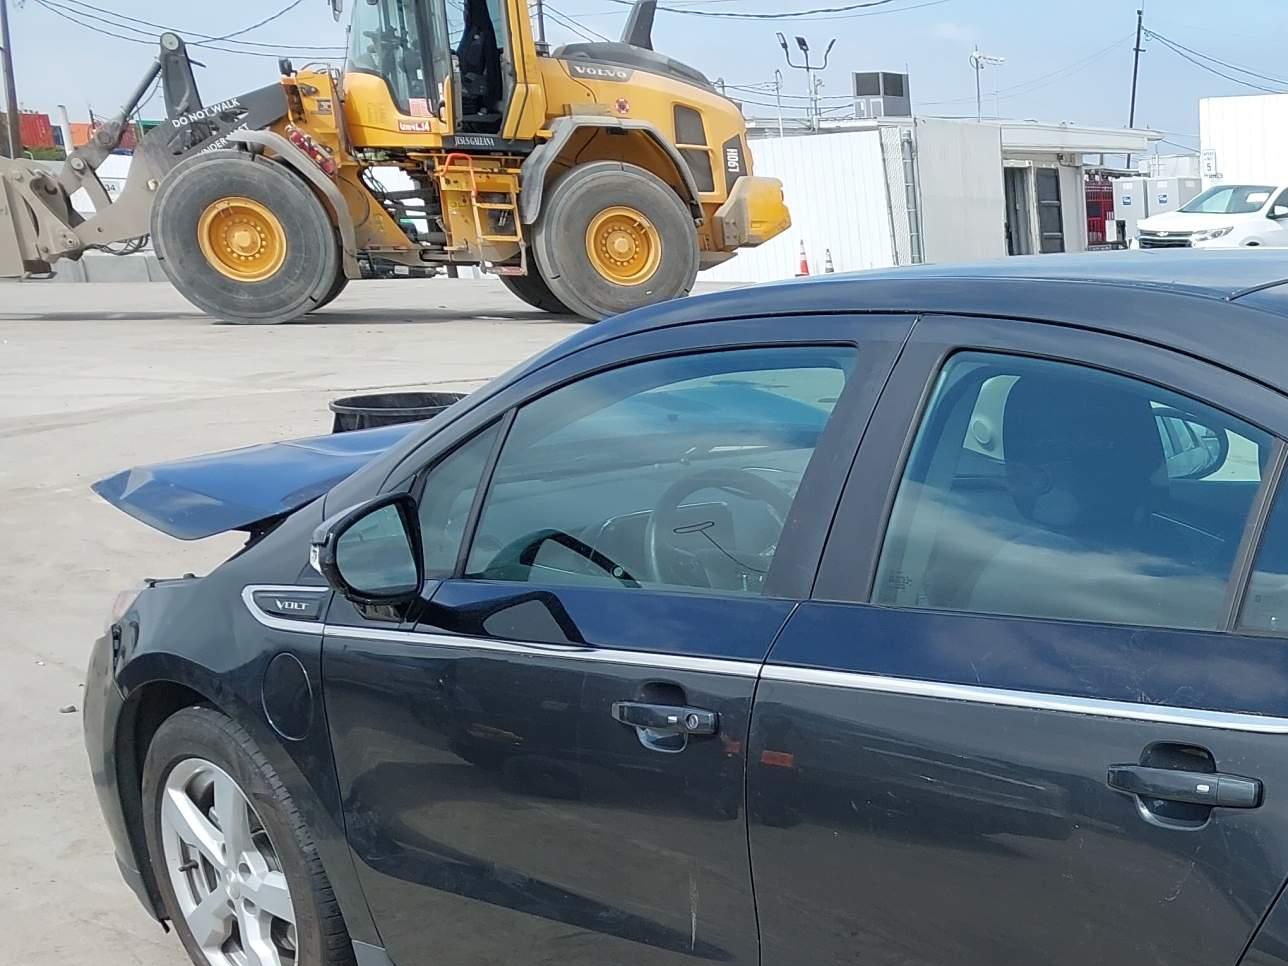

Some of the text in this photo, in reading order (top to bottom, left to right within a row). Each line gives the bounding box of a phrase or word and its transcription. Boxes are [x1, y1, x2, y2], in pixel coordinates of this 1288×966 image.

[574, 65, 627, 78] VOLVO
[172, 98, 241, 128] DO NOT WALK
[726, 148, 740, 173] L90H
[1206, 162, 1212, 171] 5
[275, 599, 309, 610] VOLT
